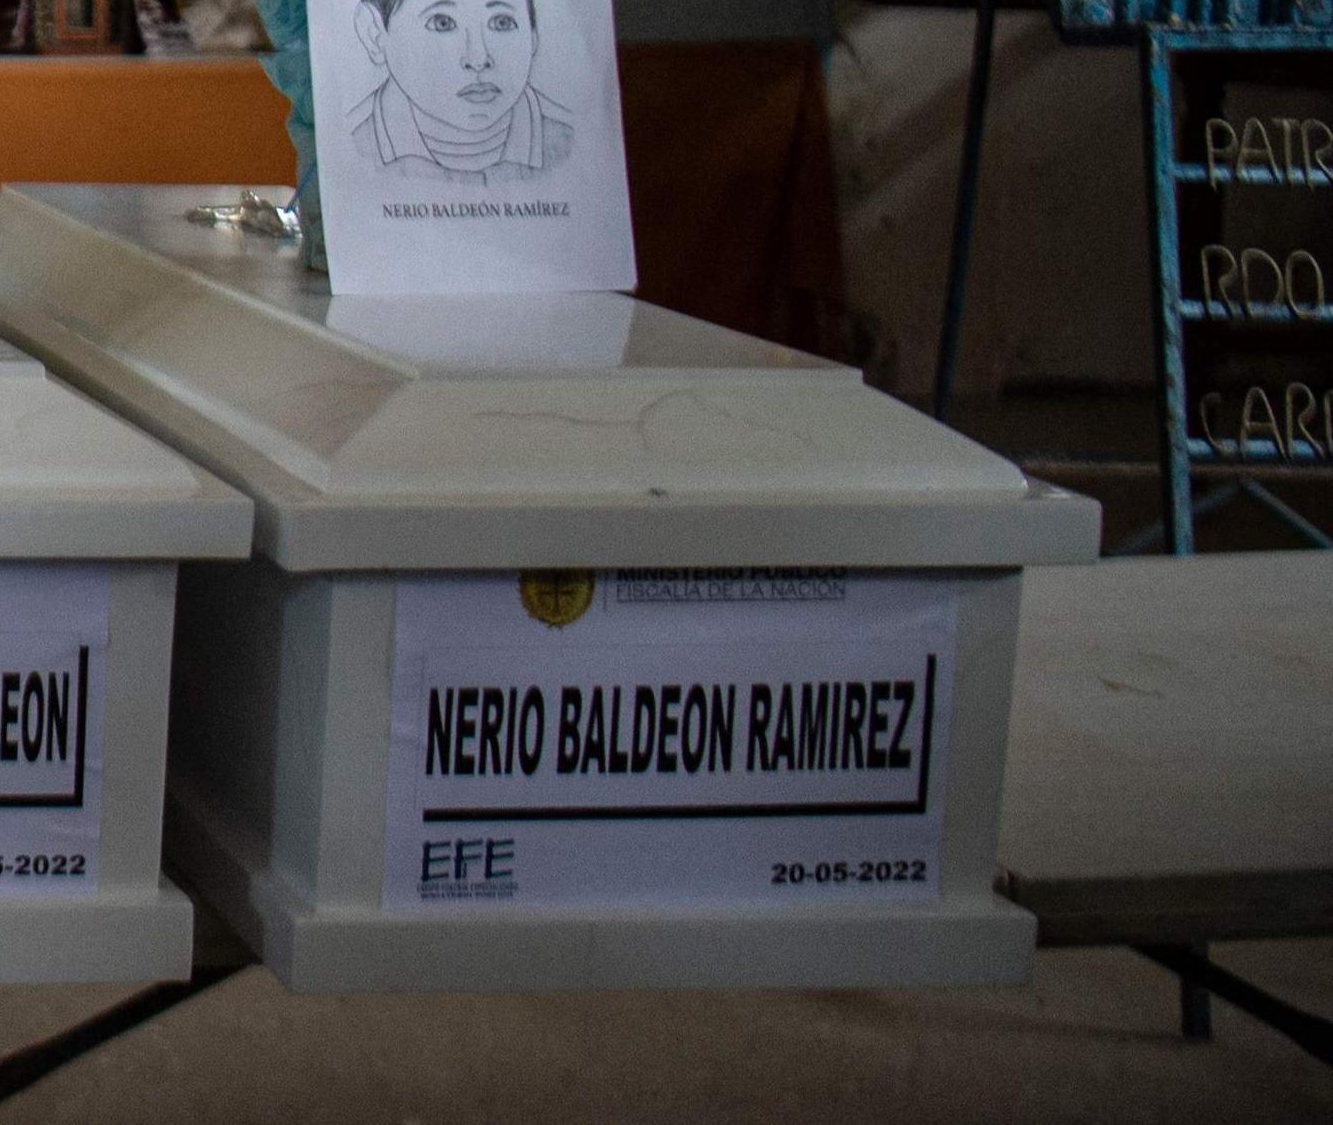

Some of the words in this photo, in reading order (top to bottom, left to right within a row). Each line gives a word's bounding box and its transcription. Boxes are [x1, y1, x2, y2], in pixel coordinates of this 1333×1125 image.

[383, 202, 428, 219] NERIO
[432, 199, 501, 219] BALDEÓN
[503, 199, 570, 218] RAMÍREZ
[1200, 381, 1333, 462] CAR
[708, 583, 733, 598] DE
[741, 583, 765, 598] LA
[425, 684, 546, 776] NERIO
[556, 683, 736, 775] BALDEON
[746, 680, 916, 772] RAMIREZ
[421, 838, 515, 882] EFE
[771, 859, 928, 885] 20-05-2022
